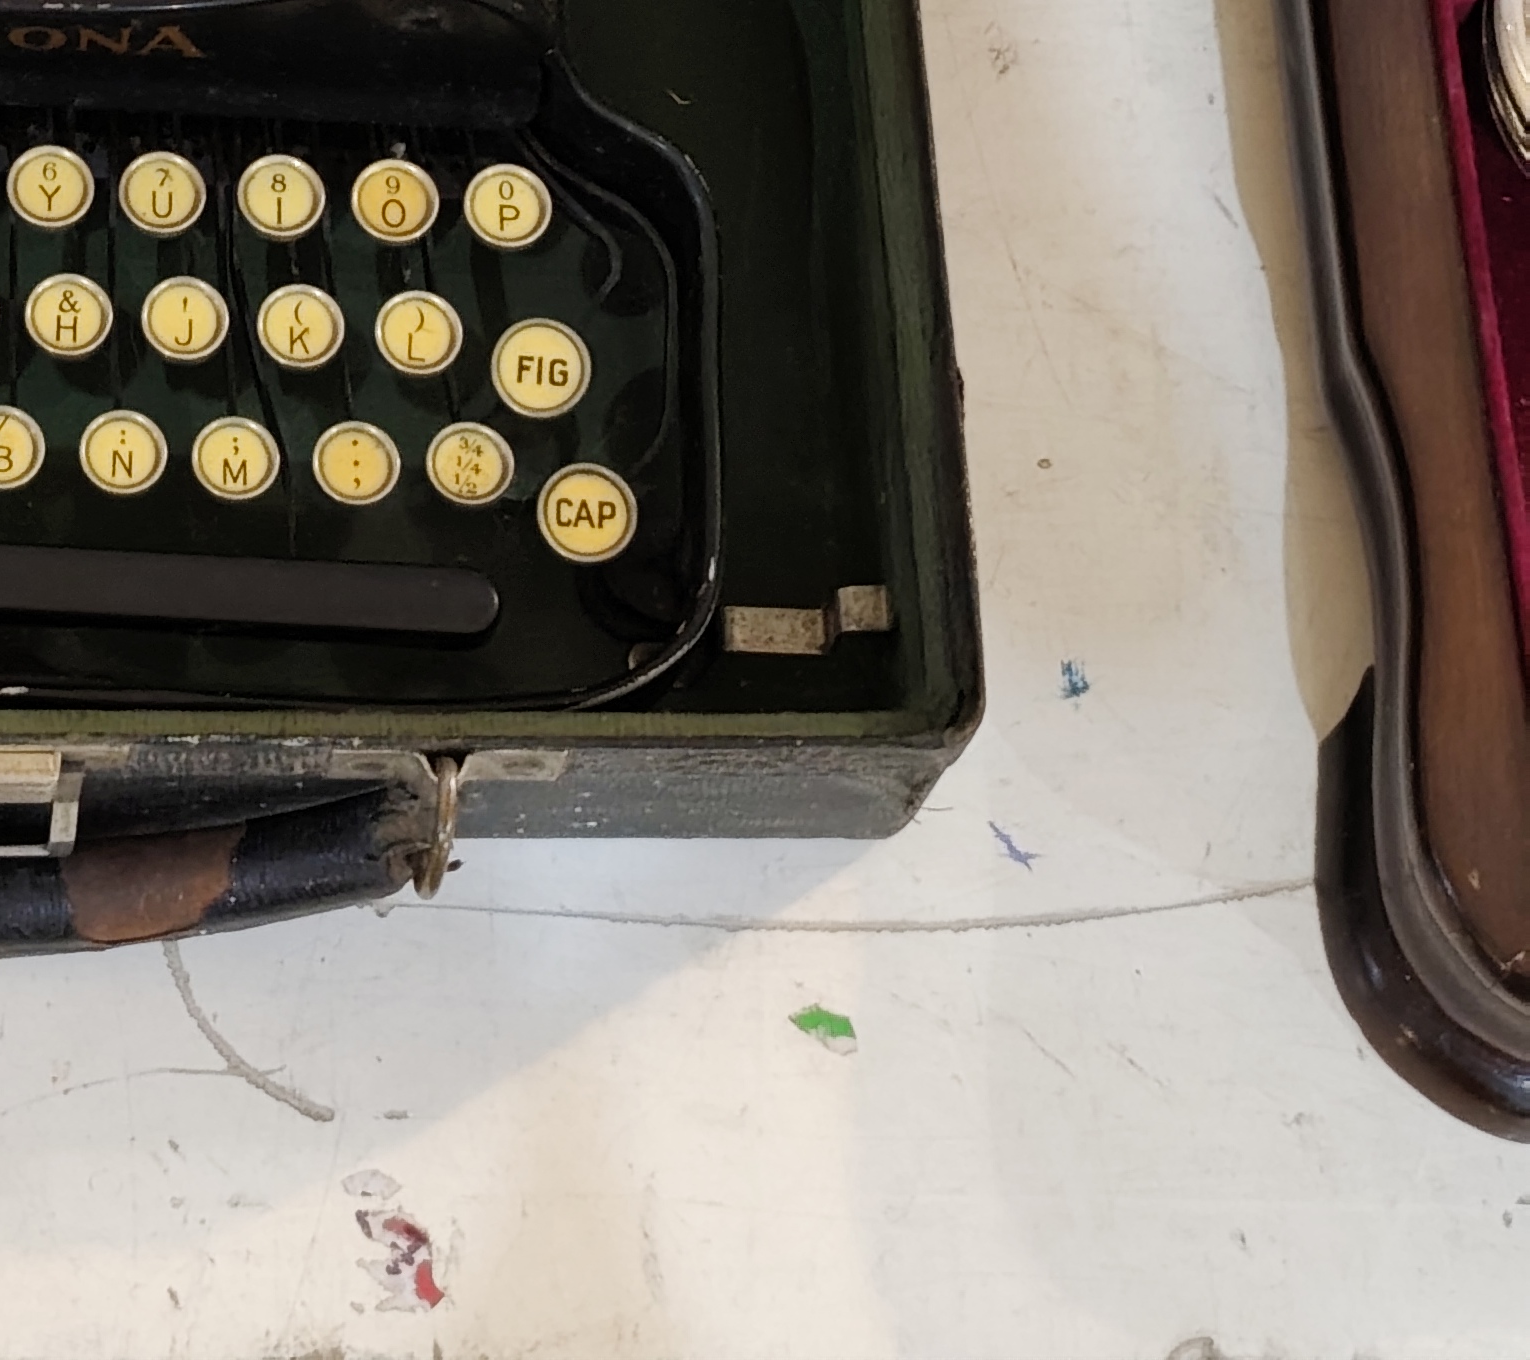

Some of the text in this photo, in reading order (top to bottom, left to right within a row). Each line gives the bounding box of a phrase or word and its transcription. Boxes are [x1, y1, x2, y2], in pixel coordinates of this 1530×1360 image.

[42, 162, 57, 181] 6
[270, 173, 287, 193] 8
[385, 175, 401, 195] 9
[38, 184, 62, 212] Y
[151, 190, 173, 219] U
[498, 180, 515, 201] 0
[276, 196, 283, 225] I
[381, 198, 407, 229] O
[498, 204, 521, 232] P
[58, 289, 81, 314] &
[55, 314, 78, 344] H
[174, 318, 193, 347] J
[289, 326, 310, 355] K
[407, 332, 426, 363] L
[516, 355, 569, 387] FIG
[111, 449, 133, 479] N
[222, 457, 248, 486] M
[555, 497, 617, 530] CAP
